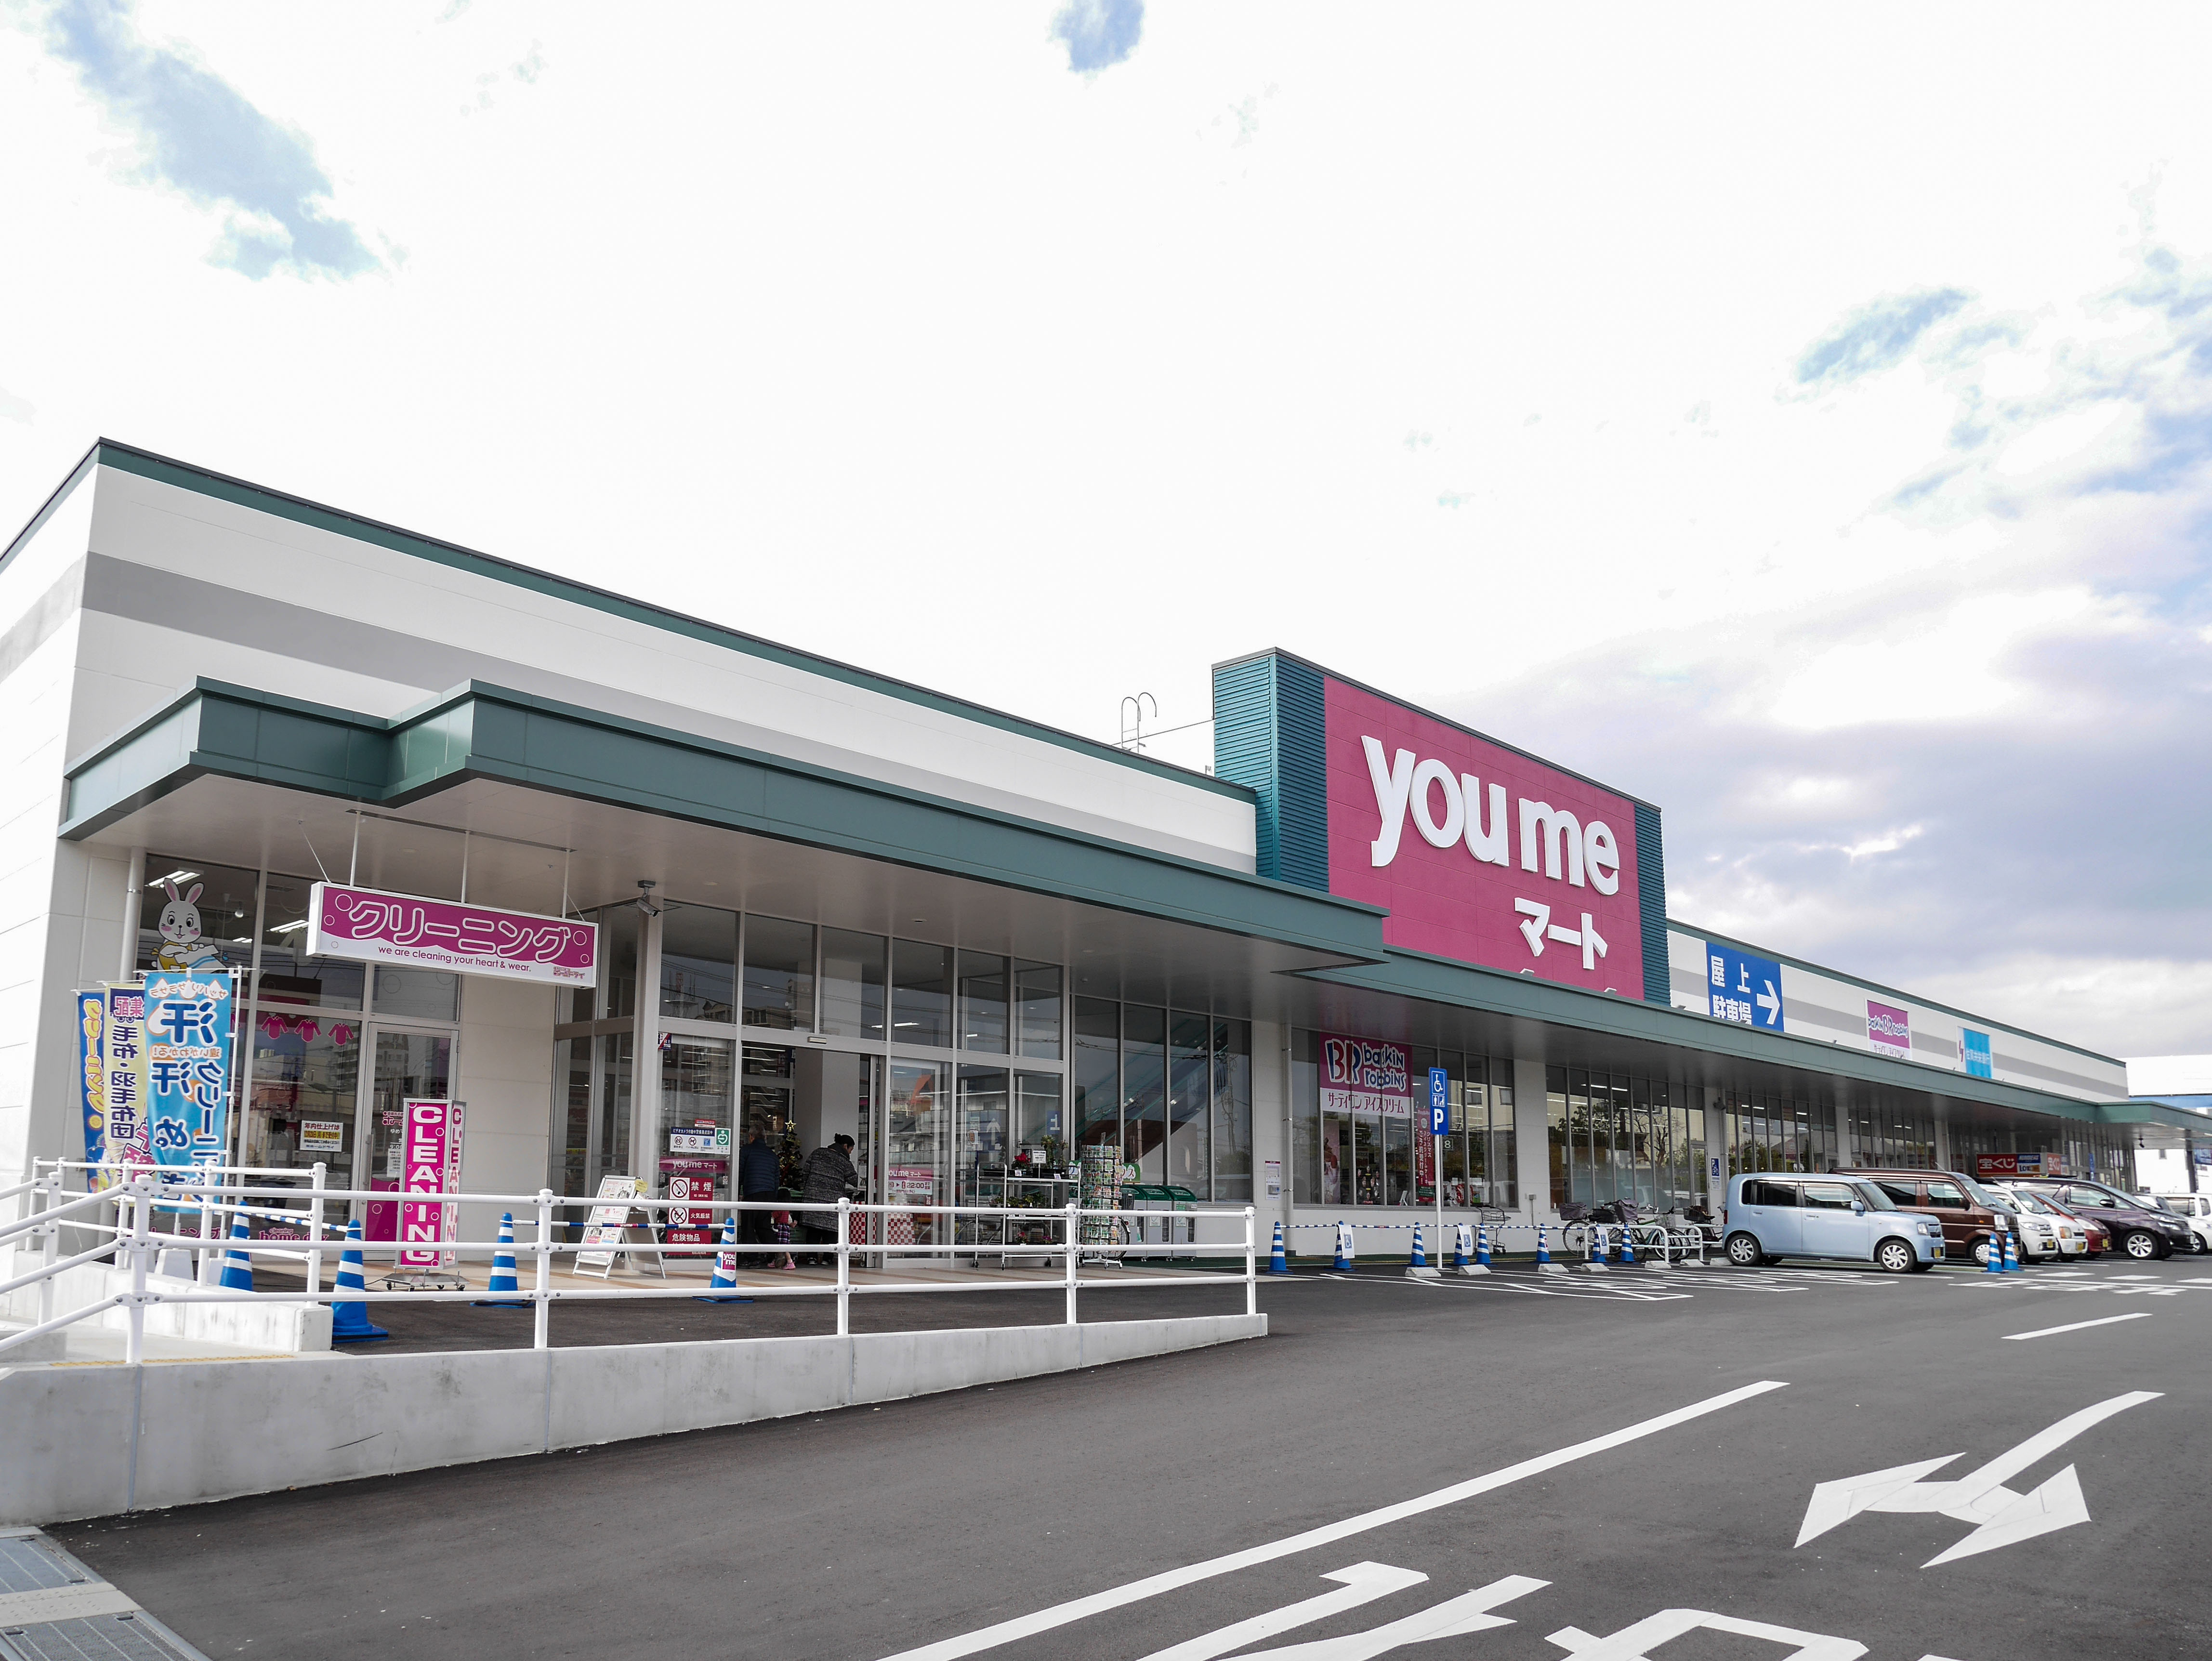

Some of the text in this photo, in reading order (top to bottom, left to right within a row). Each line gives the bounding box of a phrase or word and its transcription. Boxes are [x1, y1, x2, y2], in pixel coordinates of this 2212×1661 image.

[349, 901, 571, 963] クリーニング
[1514, 897, 1607, 970] マート
[412, 950, 451, 963] cleaning
[454, 956, 474, 966] your
[475, 958, 499, 968] heart
[508, 962, 531, 972] wear.
[1711, 955, 1751, 993] 屋上
[1712, 994, 1752, 1025] 駐車場
[1325, 1039, 1363, 1084] BR
[1364, 1096, 1405, 1114] アイスクリーム
[304, 1122, 340, 1131] 年内仕上げは
[1434, 1108, 1444, 1130] P
[1445, 1139, 1451, 1148] 8
[1979, 1158, 2015, 1169] 宝くじ
[691, 1181, 712, 1191] 禁煙
[672, 1233, 700, 1242] 危険物品
